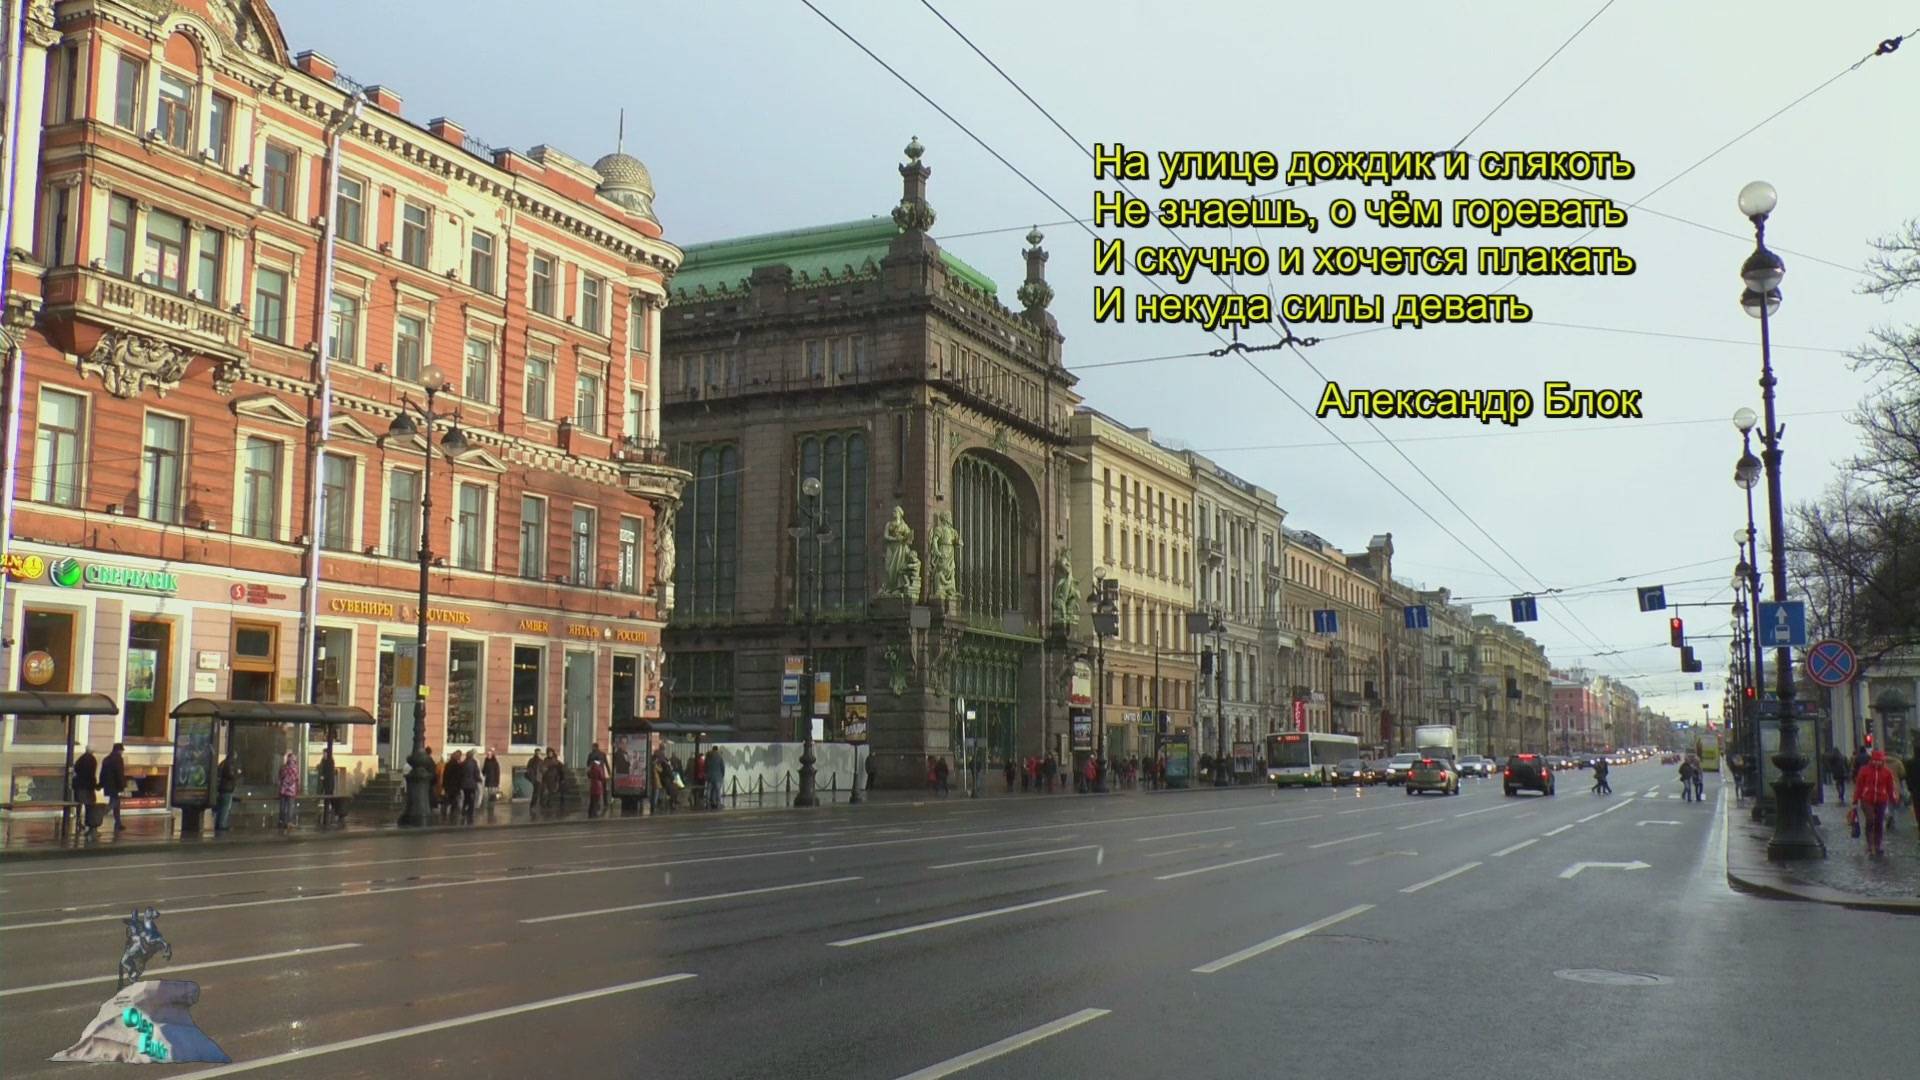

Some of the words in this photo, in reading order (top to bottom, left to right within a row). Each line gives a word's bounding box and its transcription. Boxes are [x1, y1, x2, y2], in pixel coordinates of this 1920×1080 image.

[331, 599, 394, 620] СУВЕНИРЫ
[519, 619, 549, 633] AMBER
[568, 623, 600, 638] ЯНТАРЬ
[616, 629, 648, 642] РОССИИ
